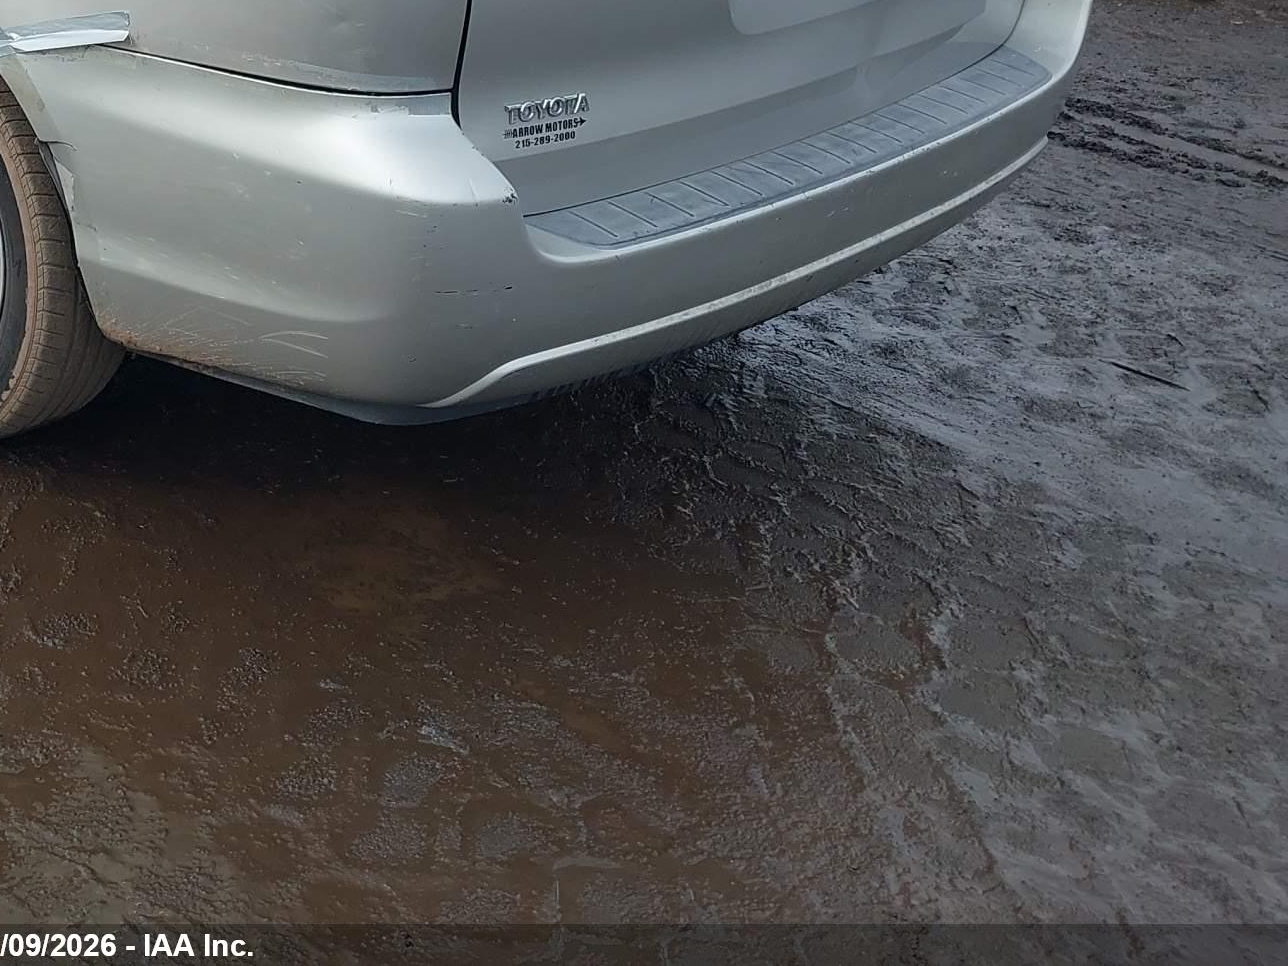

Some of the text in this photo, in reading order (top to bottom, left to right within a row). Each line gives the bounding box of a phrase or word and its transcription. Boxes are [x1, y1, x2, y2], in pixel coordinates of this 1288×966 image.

[504, 93, 590, 124] TOYOTA
[512, 117, 579, 139] ARROW MOTORS
[514, 130, 576, 149] 215-289-2000
